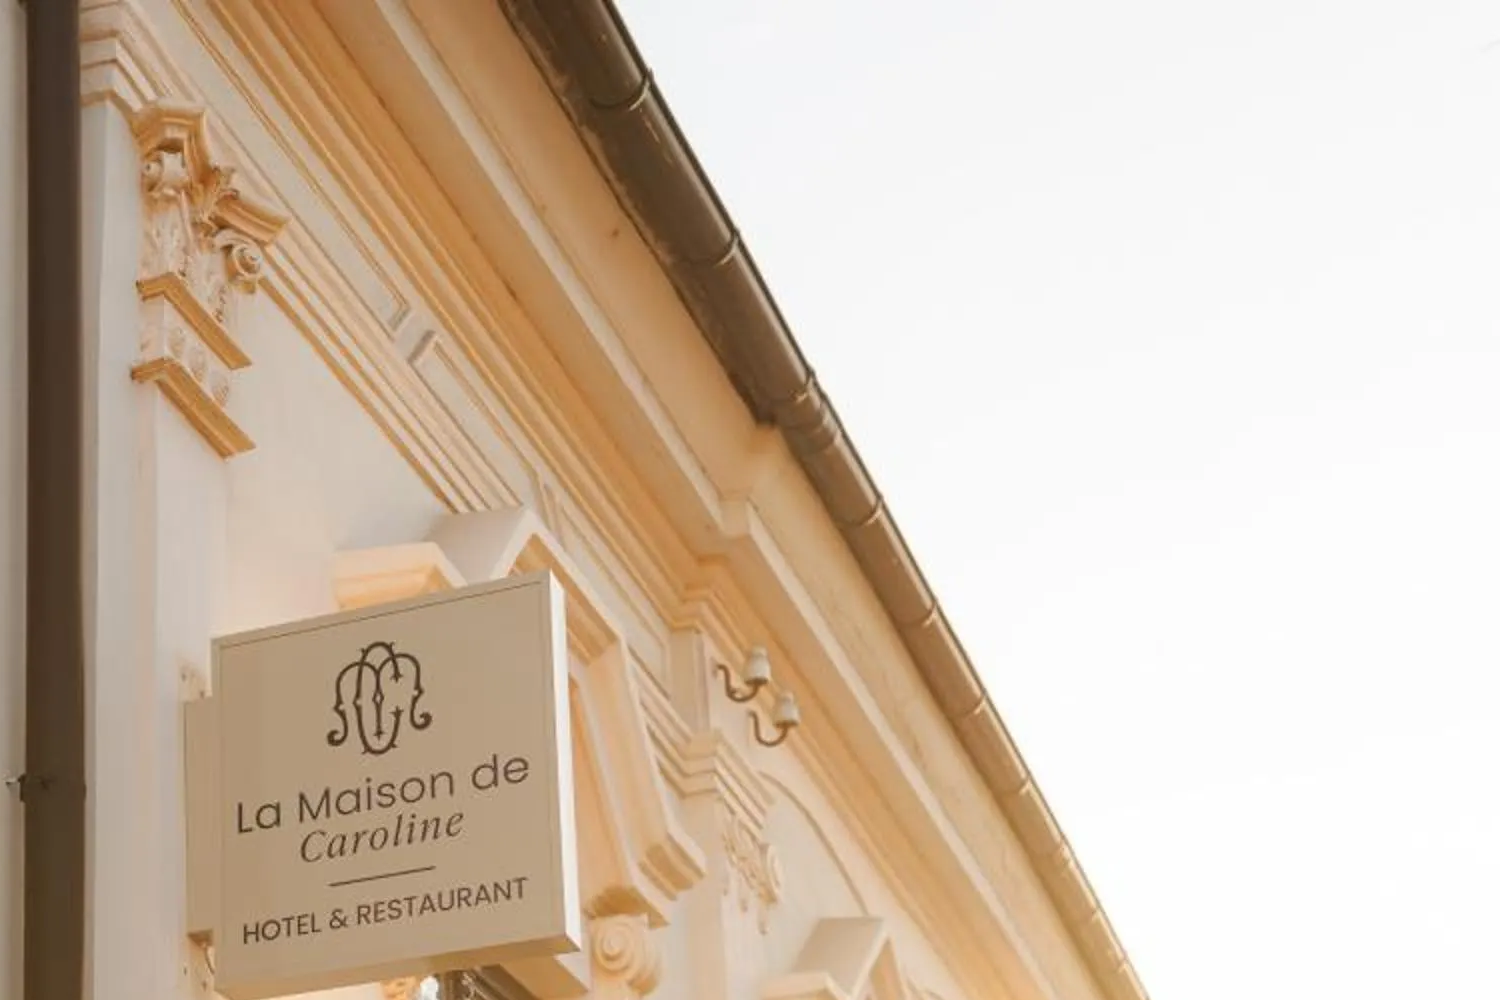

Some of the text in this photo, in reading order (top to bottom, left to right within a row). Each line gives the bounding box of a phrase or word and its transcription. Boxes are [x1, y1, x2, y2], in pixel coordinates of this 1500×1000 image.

[237, 754, 530, 835] La Maison de
[300, 811, 465, 863] Caroline
[243, 876, 528, 945] HOTEL & RESTAURANT
